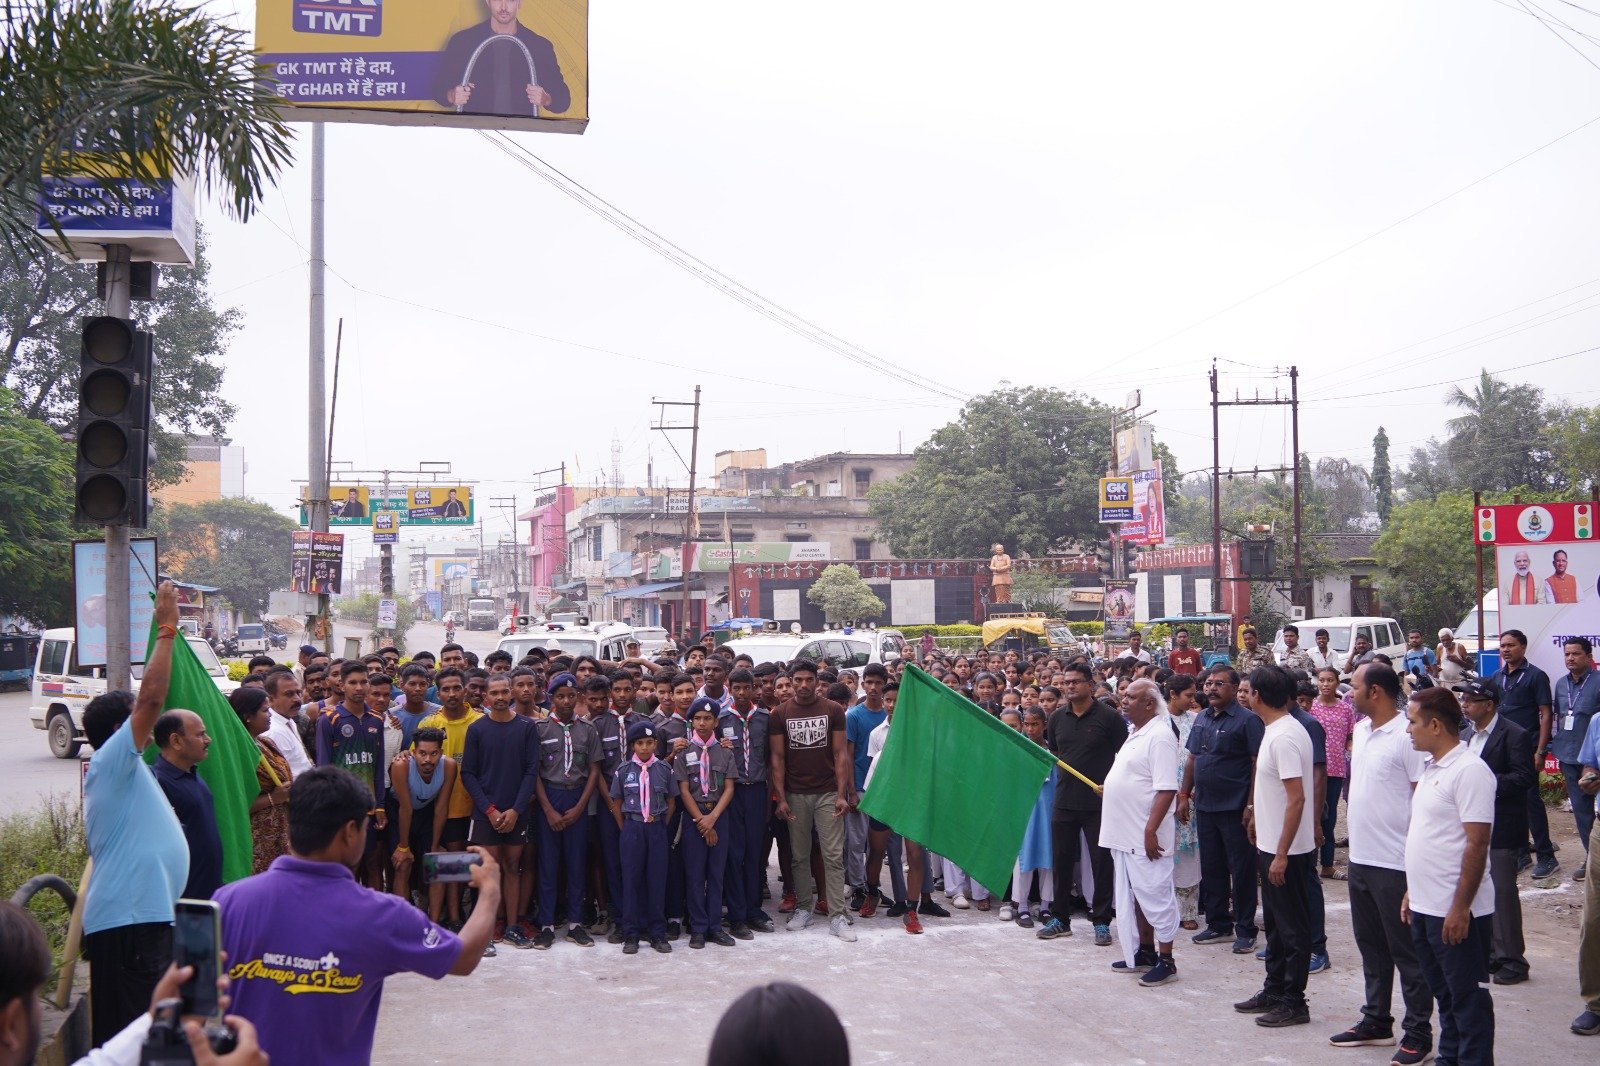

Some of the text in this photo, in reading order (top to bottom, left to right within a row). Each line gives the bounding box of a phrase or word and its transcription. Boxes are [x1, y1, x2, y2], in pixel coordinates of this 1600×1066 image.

[301, 10, 374, 33] TMT
[276, 57, 395, 76] GK TMT में है दम,
[298, 82, 344, 96] GHAR
[347, 79, 359, 95] में
[362, 78, 374, 97] हैं
[1107, 482, 1127, 493] GK
[714, 549, 739, 558] Castrol
[790, 719, 825, 730] OSAKA
[791, 730, 825, 744] WORK WEAR
[263, 952, 320, 971] ONCE A SCOUT
[229, 959, 363, 988] Always a Scout
